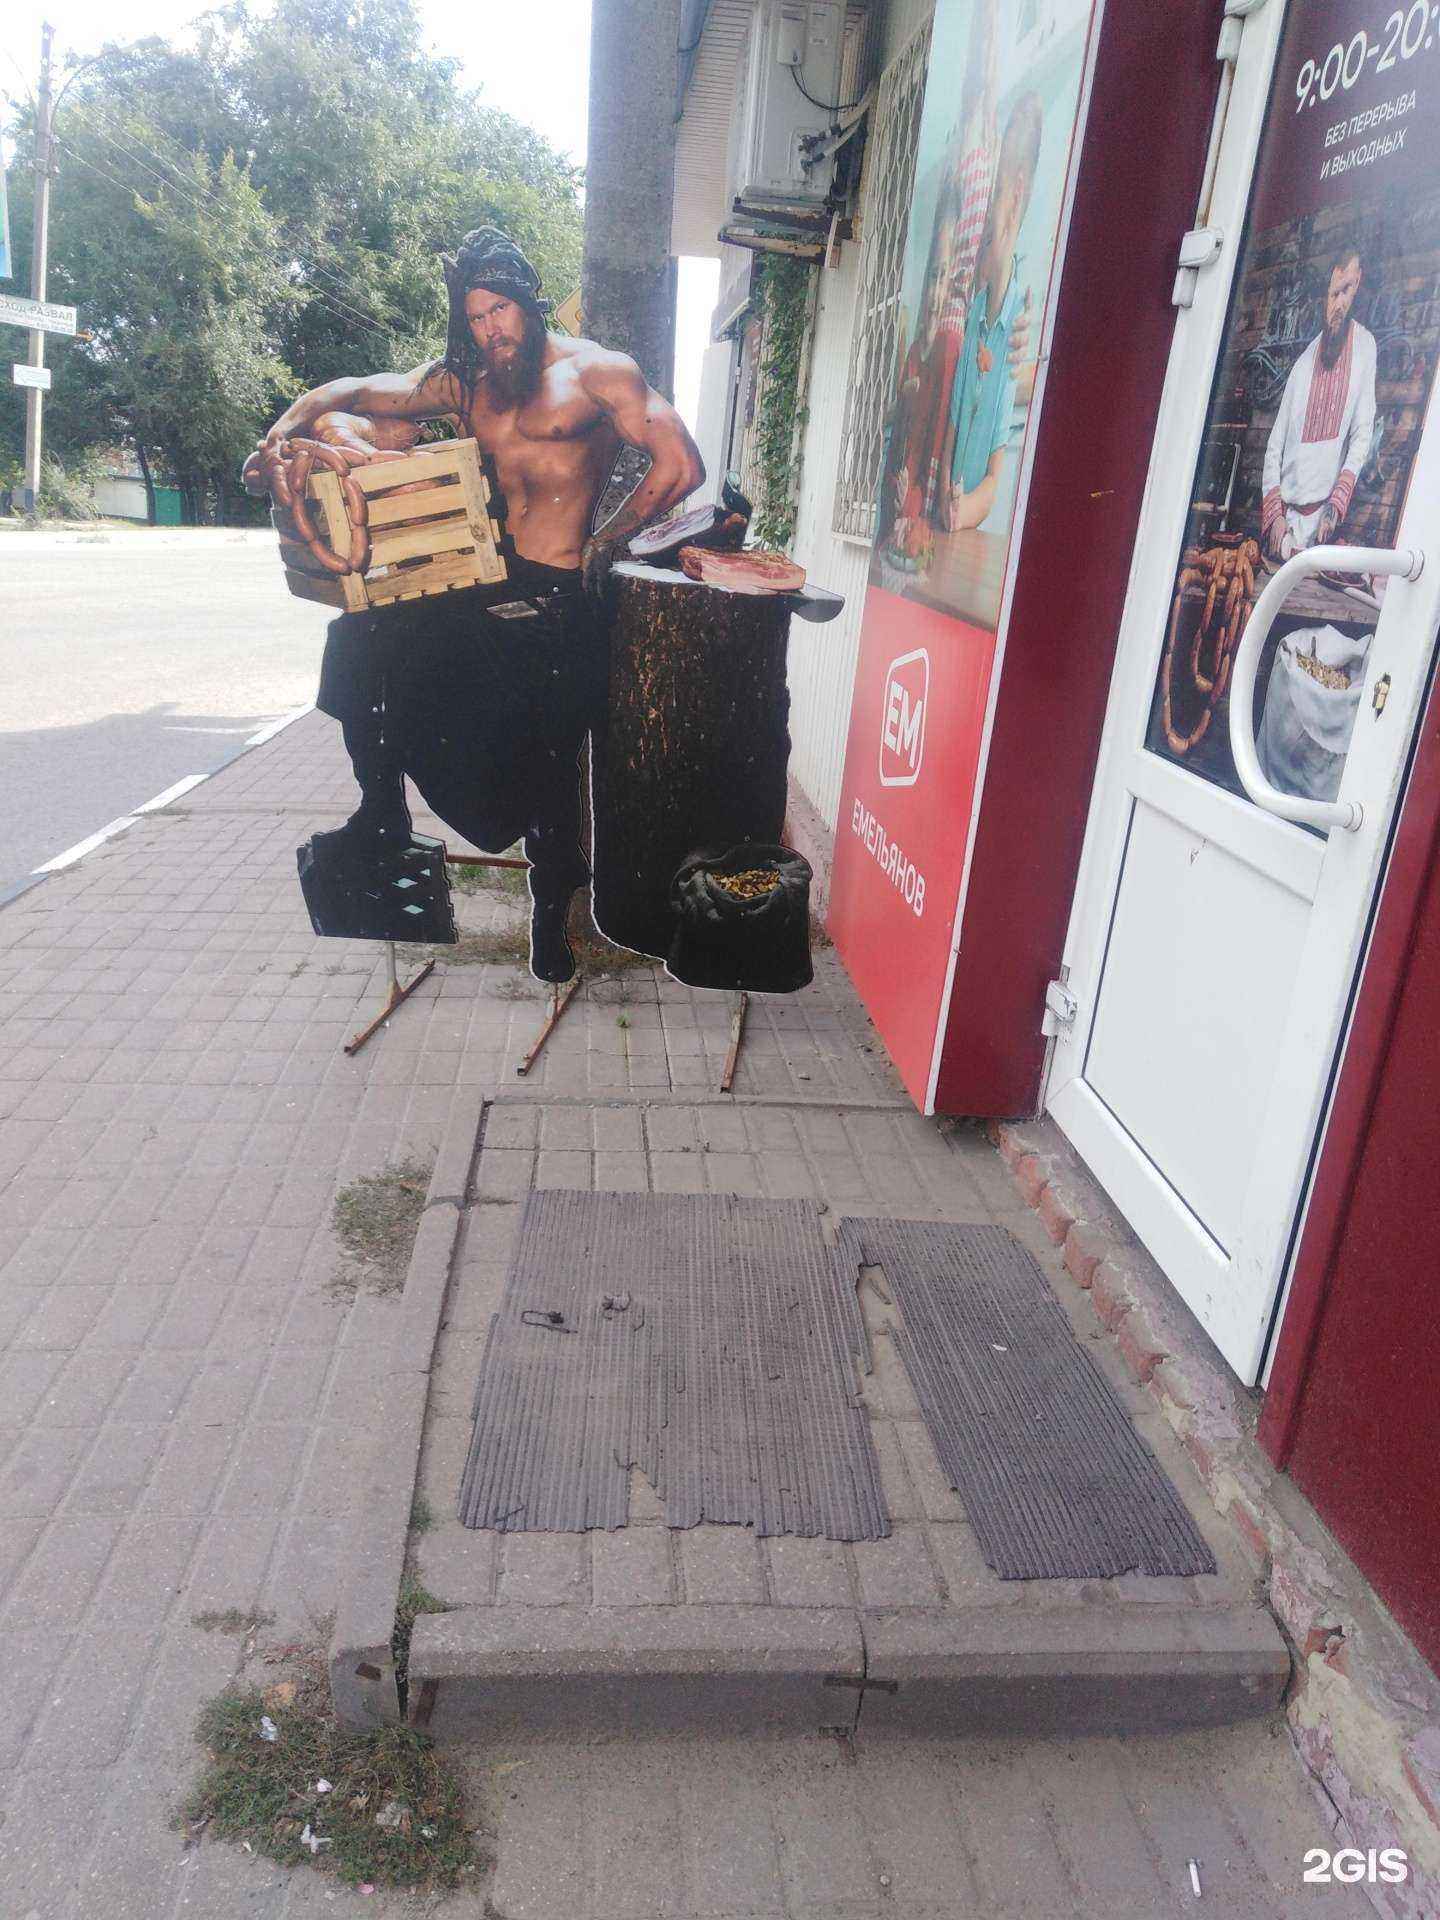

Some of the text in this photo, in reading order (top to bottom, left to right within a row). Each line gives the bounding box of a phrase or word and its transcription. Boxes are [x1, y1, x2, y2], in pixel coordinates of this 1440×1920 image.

[1296, 0, 1440, 114] 9:00-20:
[1319, 127, 1408, 181] И ВЫХОДНЫХ
[1324, 89, 1417, 148] БЕЗ ПЕРЕРЫВА
[884, 680, 923, 769] ЕМ
[852, 798, 926, 918] ЕМЕЛЬЯНОВ
